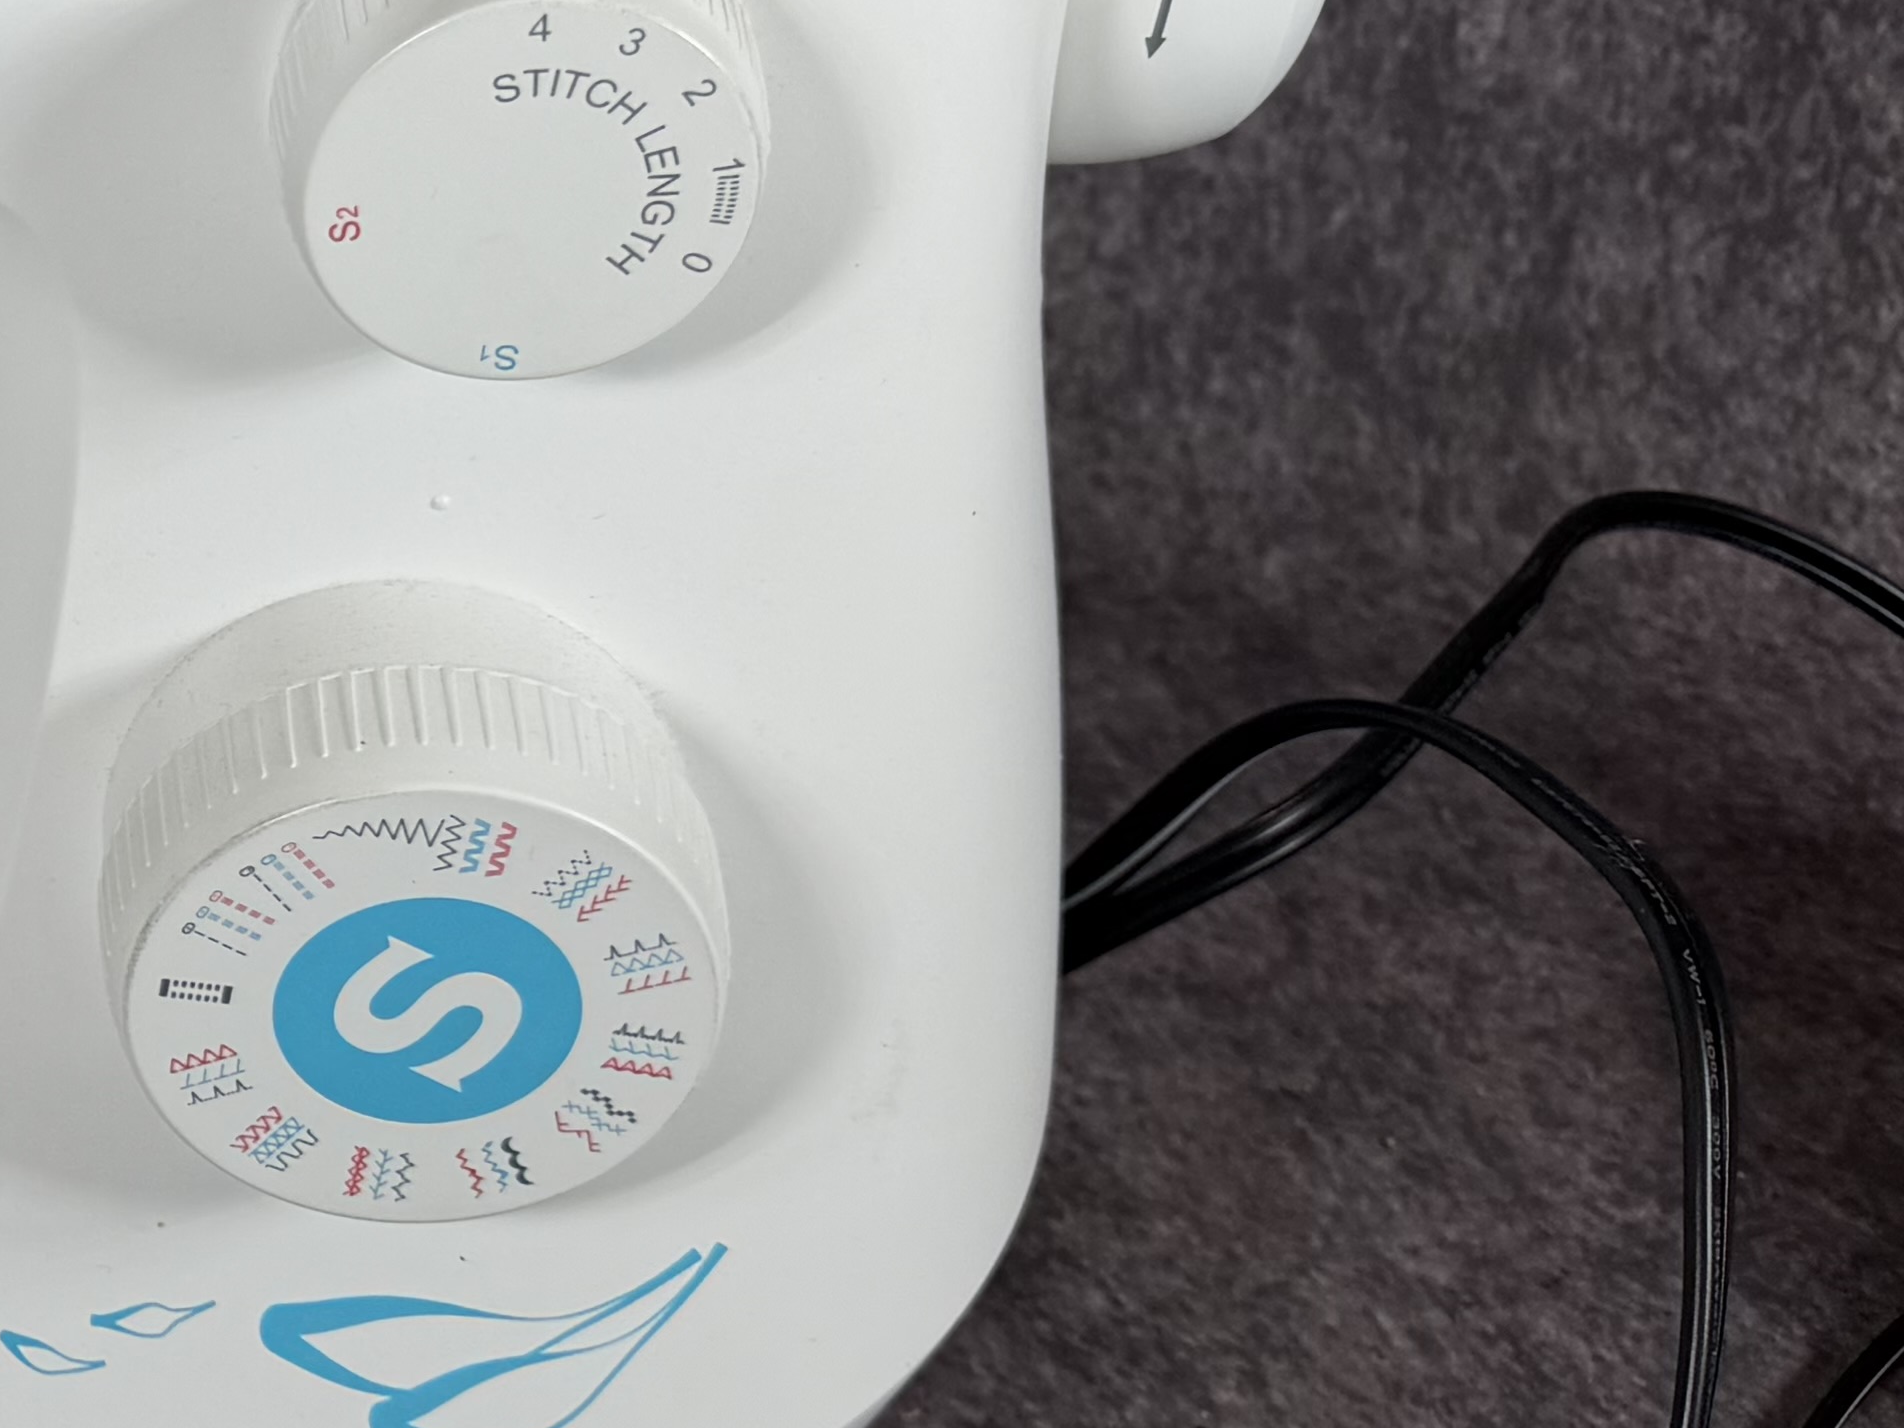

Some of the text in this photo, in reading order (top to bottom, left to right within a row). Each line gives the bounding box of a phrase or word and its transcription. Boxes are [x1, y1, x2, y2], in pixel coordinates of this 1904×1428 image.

[491, 67, 682, 277] STITCH LENGTH
[527, 12, 747, 274] 4 3 2 1 0
